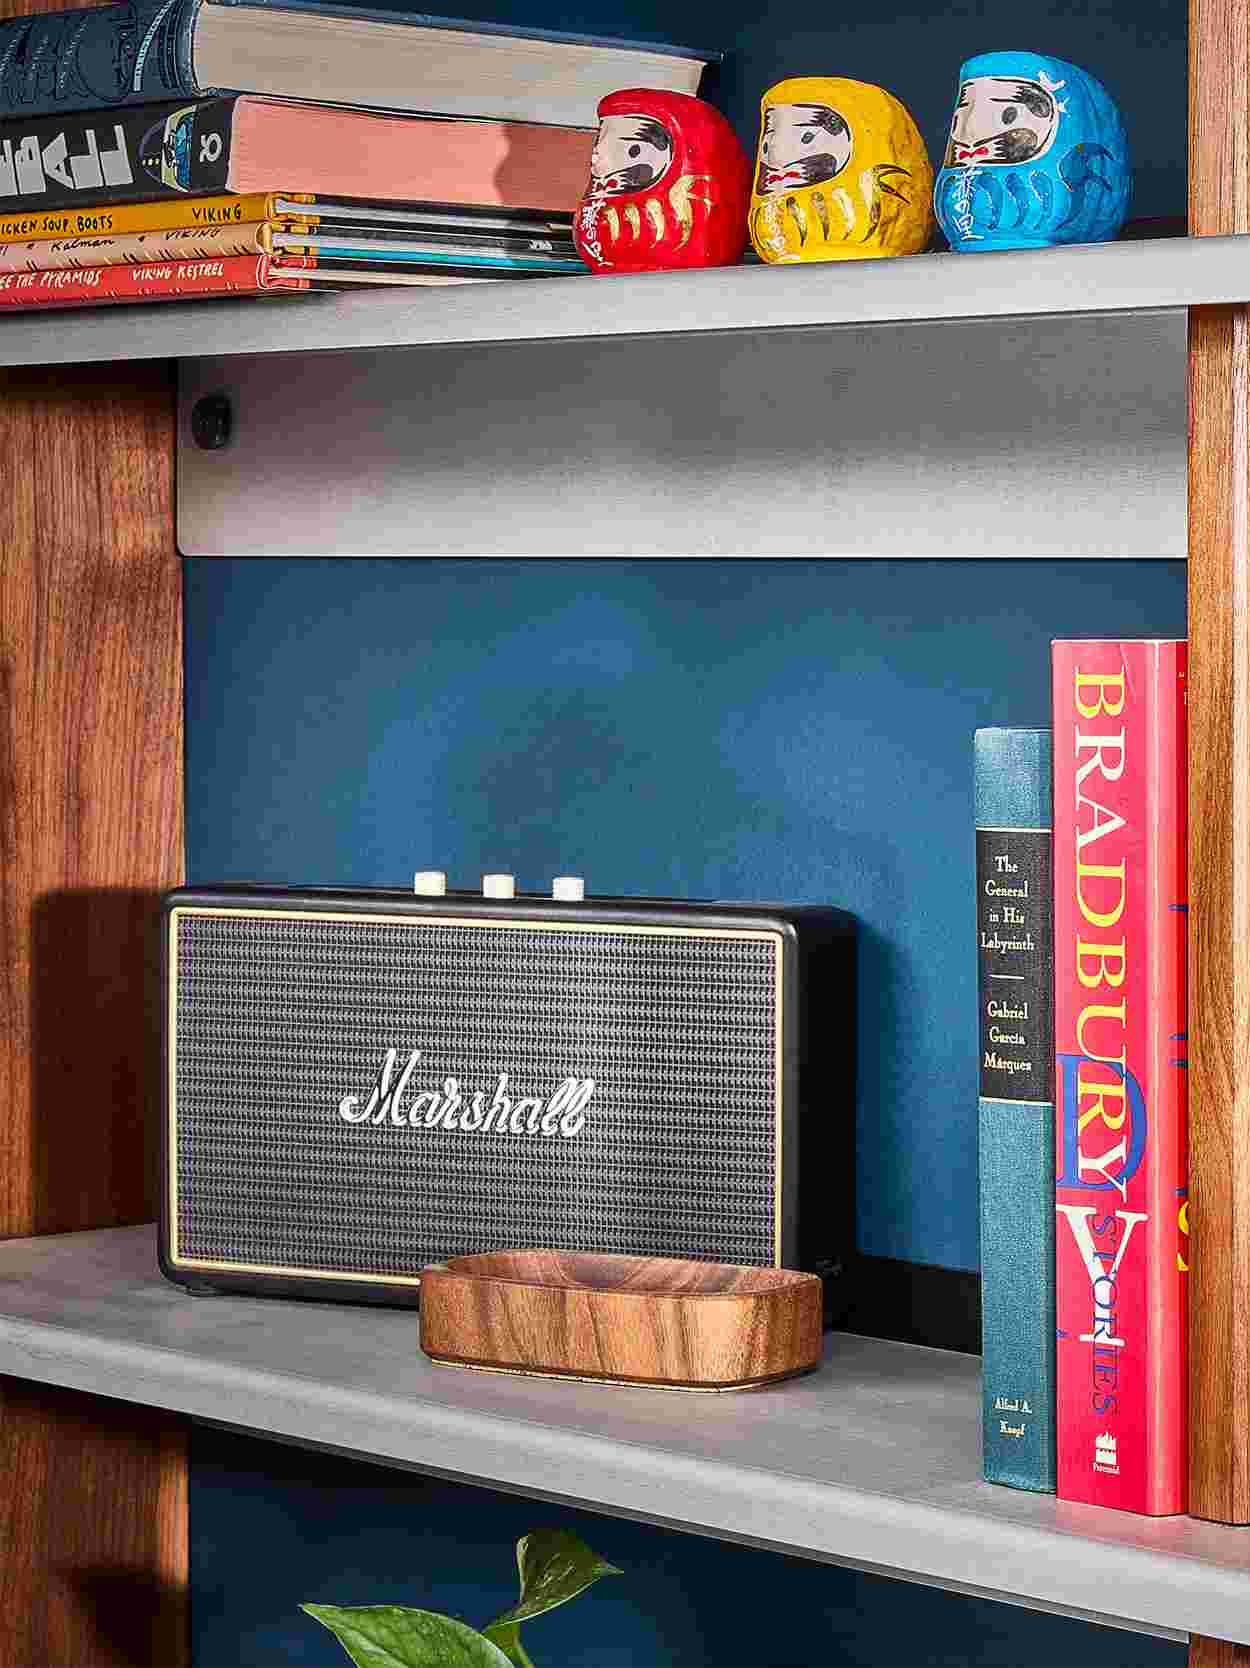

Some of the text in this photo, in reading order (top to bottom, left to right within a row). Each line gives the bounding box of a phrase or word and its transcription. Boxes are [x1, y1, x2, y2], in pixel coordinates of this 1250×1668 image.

[192, 203, 241, 222] VIKING
[77, 214, 112, 232] BOOTS
[165, 226, 221, 241] VIKING
[39, 269, 103, 289] PYRAMIDS
[132, 261, 224, 281] VIKING KESTREL
[993, 854, 1019, 873] The
[985, 879, 1029, 898] General
[989, 905, 1025, 924] in His
[980, 931, 1035, 954] Labyrinth
[1073, 665, 1128, 1203] BRADBURY
[986, 1000, 1029, 1020] Gabriel
[339, 1047, 594, 1138] Marshall
[1092, 1215, 1121, 1416] STORIES
